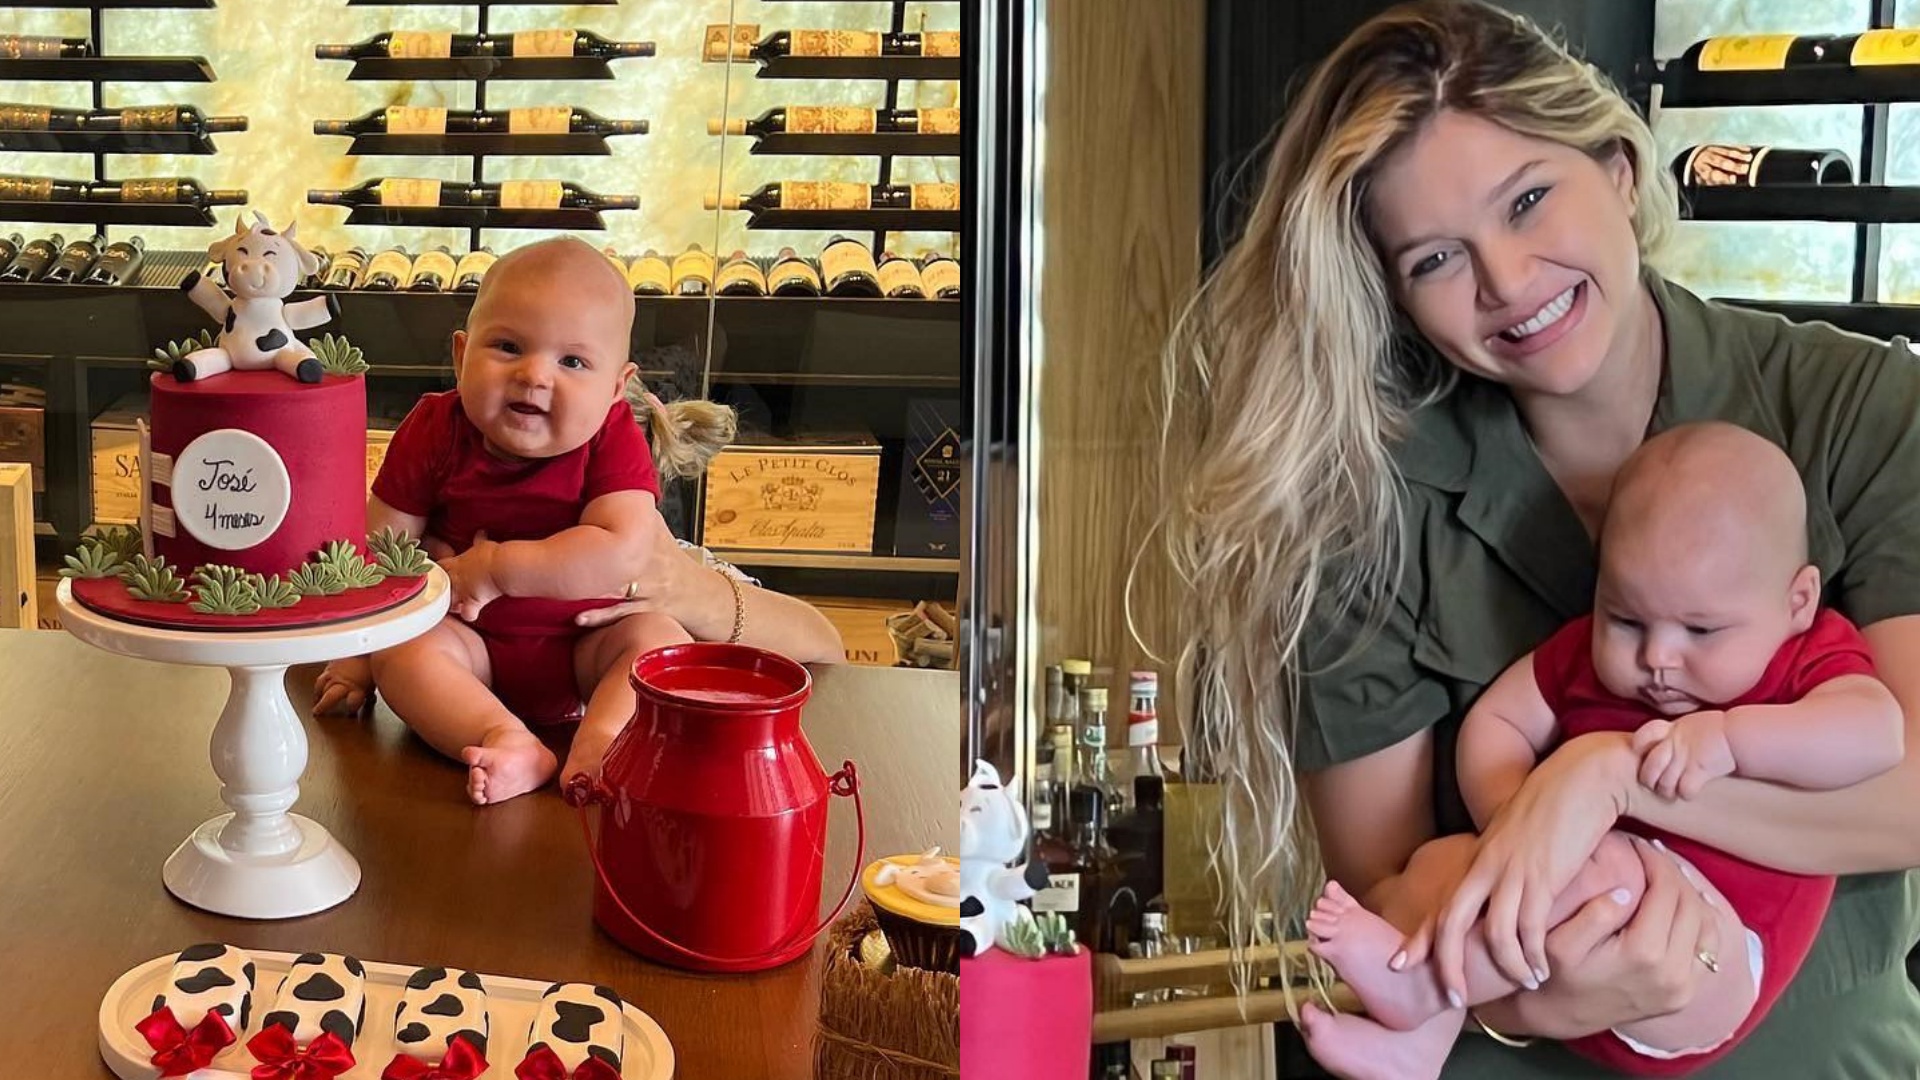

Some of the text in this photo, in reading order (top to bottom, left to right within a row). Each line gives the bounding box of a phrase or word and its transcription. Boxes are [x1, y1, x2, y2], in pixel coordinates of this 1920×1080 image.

[199, 458, 257, 492] José
[758, 457, 810, 472] PETIT
[815, 457, 857, 487] CLOS
[205, 503, 265, 530] 4 meses
